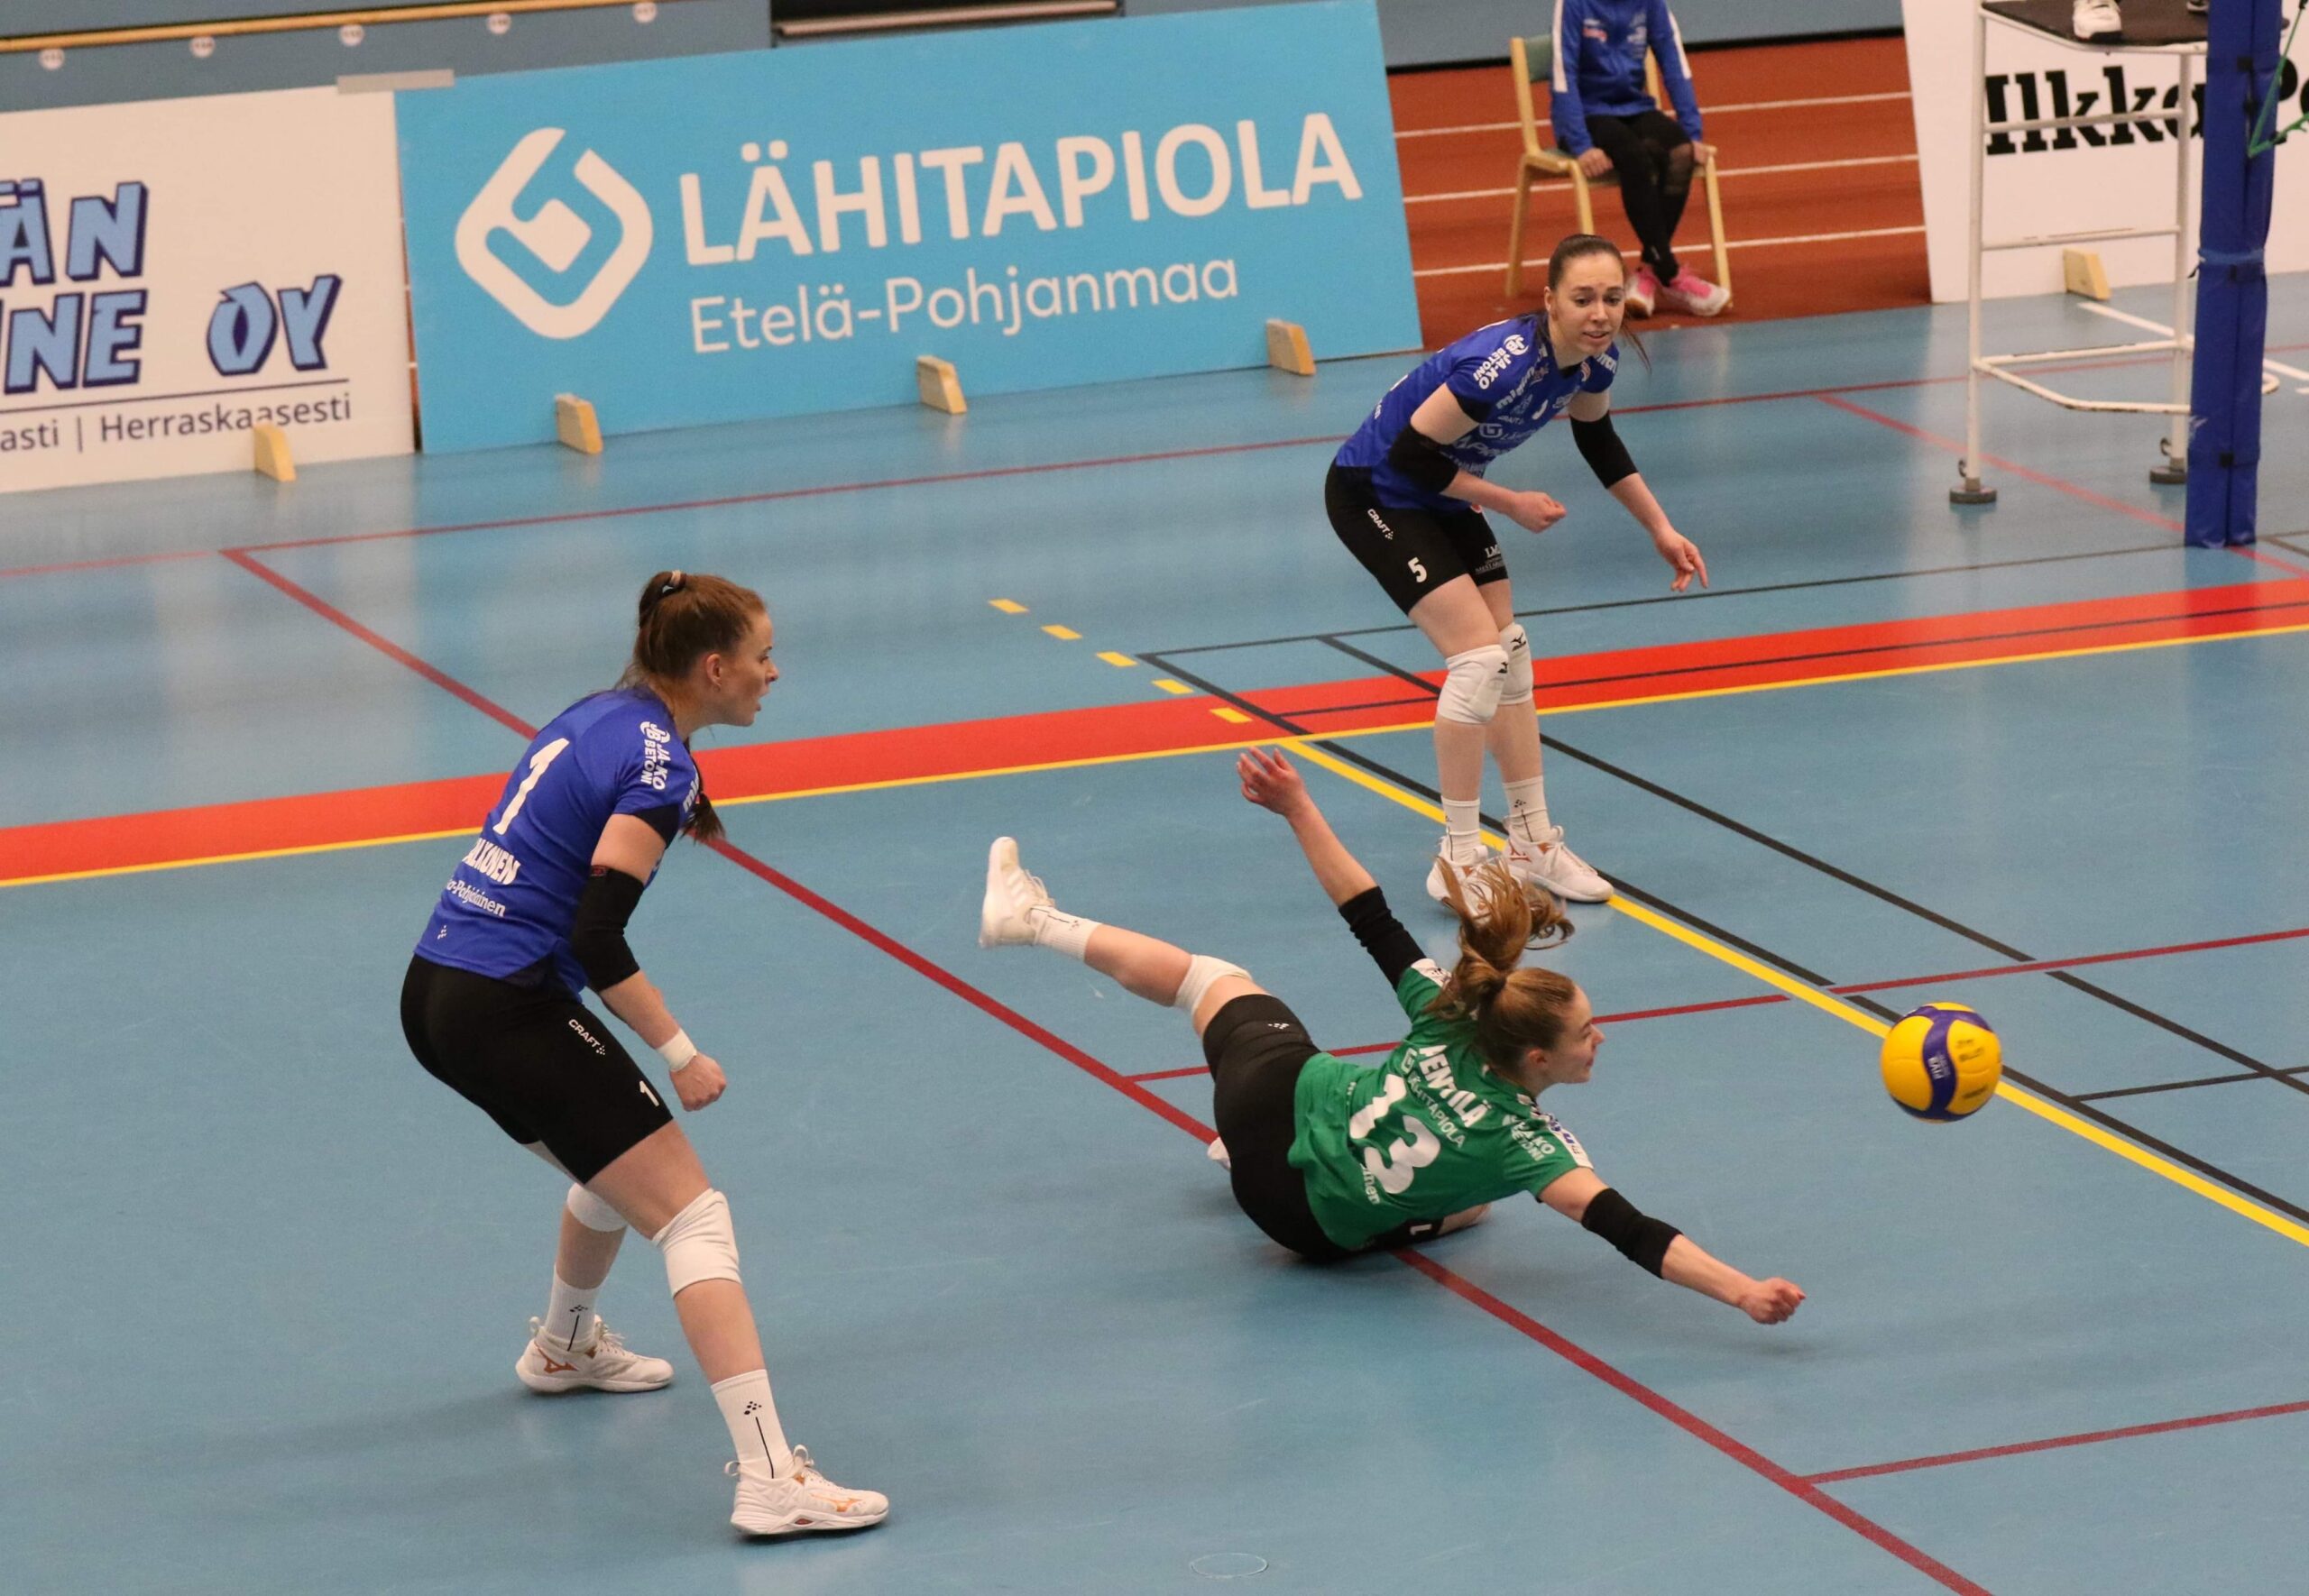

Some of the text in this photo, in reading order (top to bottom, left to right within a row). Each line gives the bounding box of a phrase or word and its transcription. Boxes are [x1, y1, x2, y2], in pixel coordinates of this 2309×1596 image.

[680, 112, 1364, 266] LÄHITAPIOLA
[206, 273, 343, 377] OY
[690, 258, 1239, 353] Etelä-Pohjanmaa
[1478, 353, 1512, 390] JA-KO
[1367, 509, 1391, 534] CRAFT
[1407, 556, 1428, 583] 5
[640, 738, 658, 785] BETONI
[652, 743, 671, 791] JA-KO
[492, 737, 570, 836] 1
[568, 1019, 601, 1049] CRAFT
[639, 1080, 659, 1107] 1
[1349, 1073, 1441, 1195] 13
